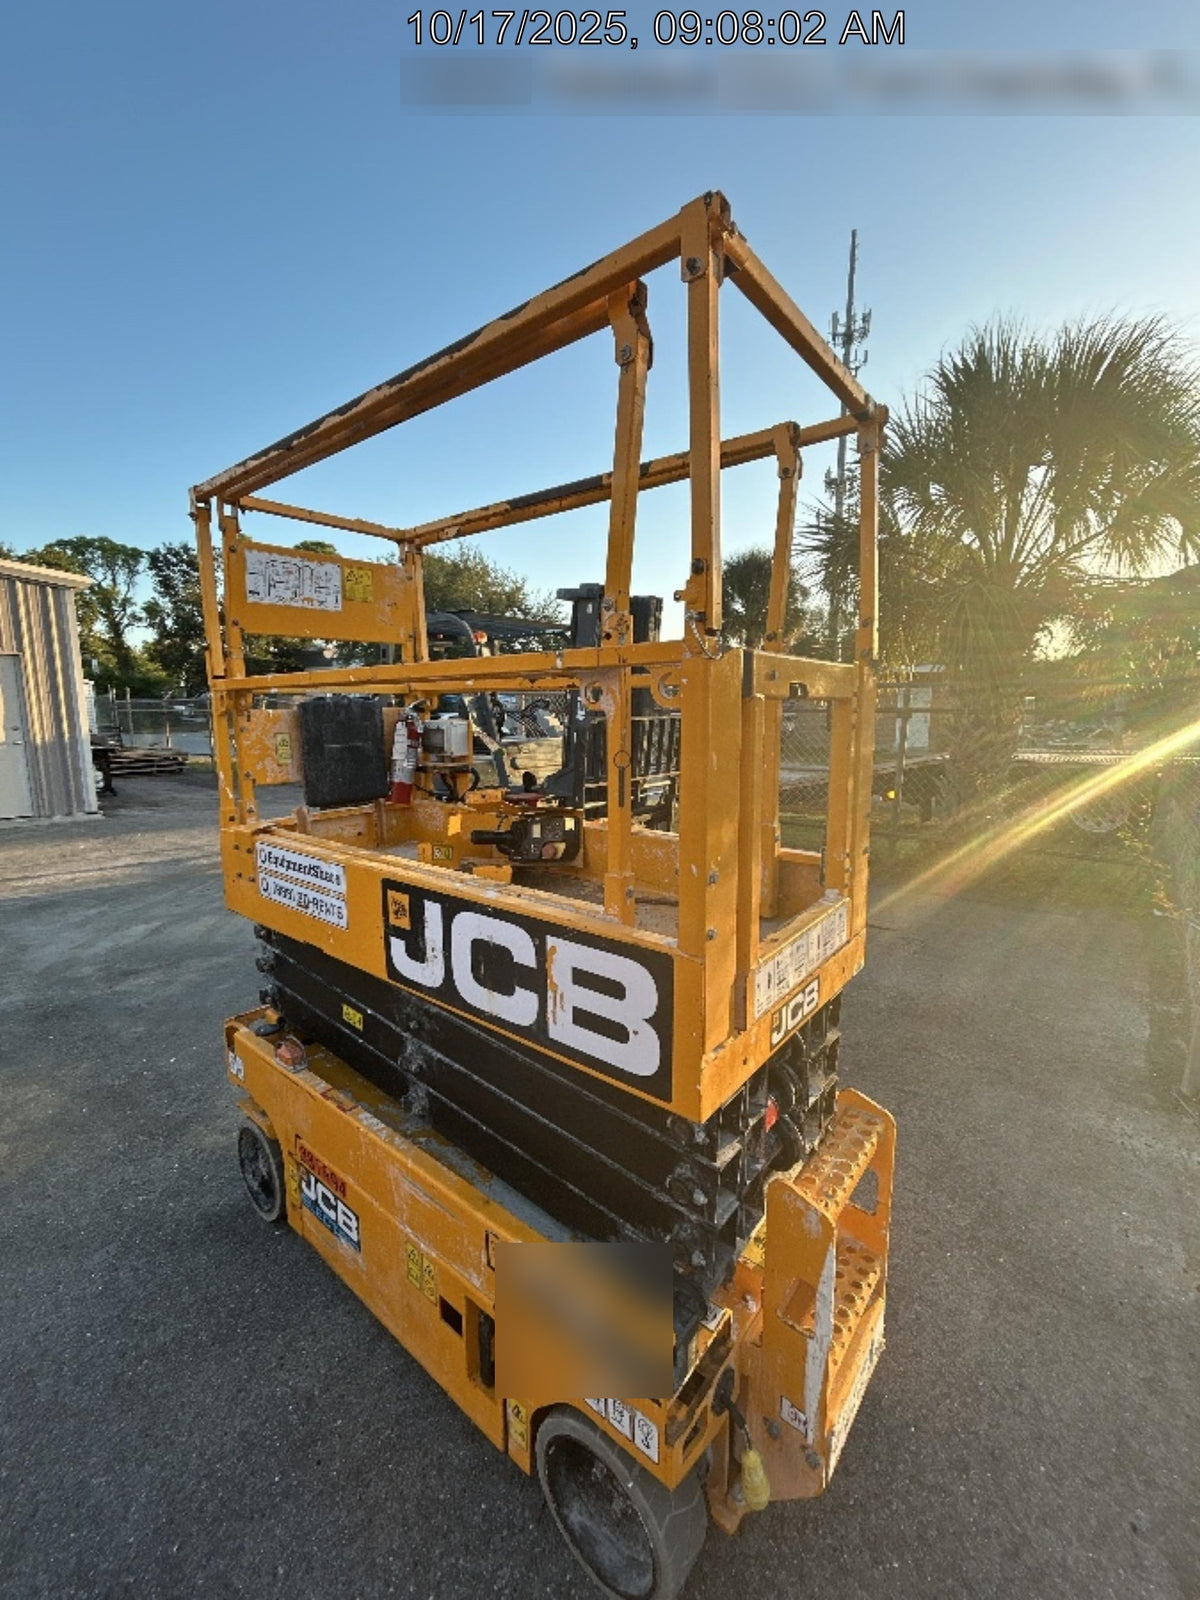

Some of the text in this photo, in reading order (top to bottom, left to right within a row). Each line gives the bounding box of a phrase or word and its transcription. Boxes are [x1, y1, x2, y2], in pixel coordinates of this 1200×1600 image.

[390, 899, 661, 1077] JCB
[771, 978, 819, 1046] JCB
[301, 1174, 359, 1243] JCB
